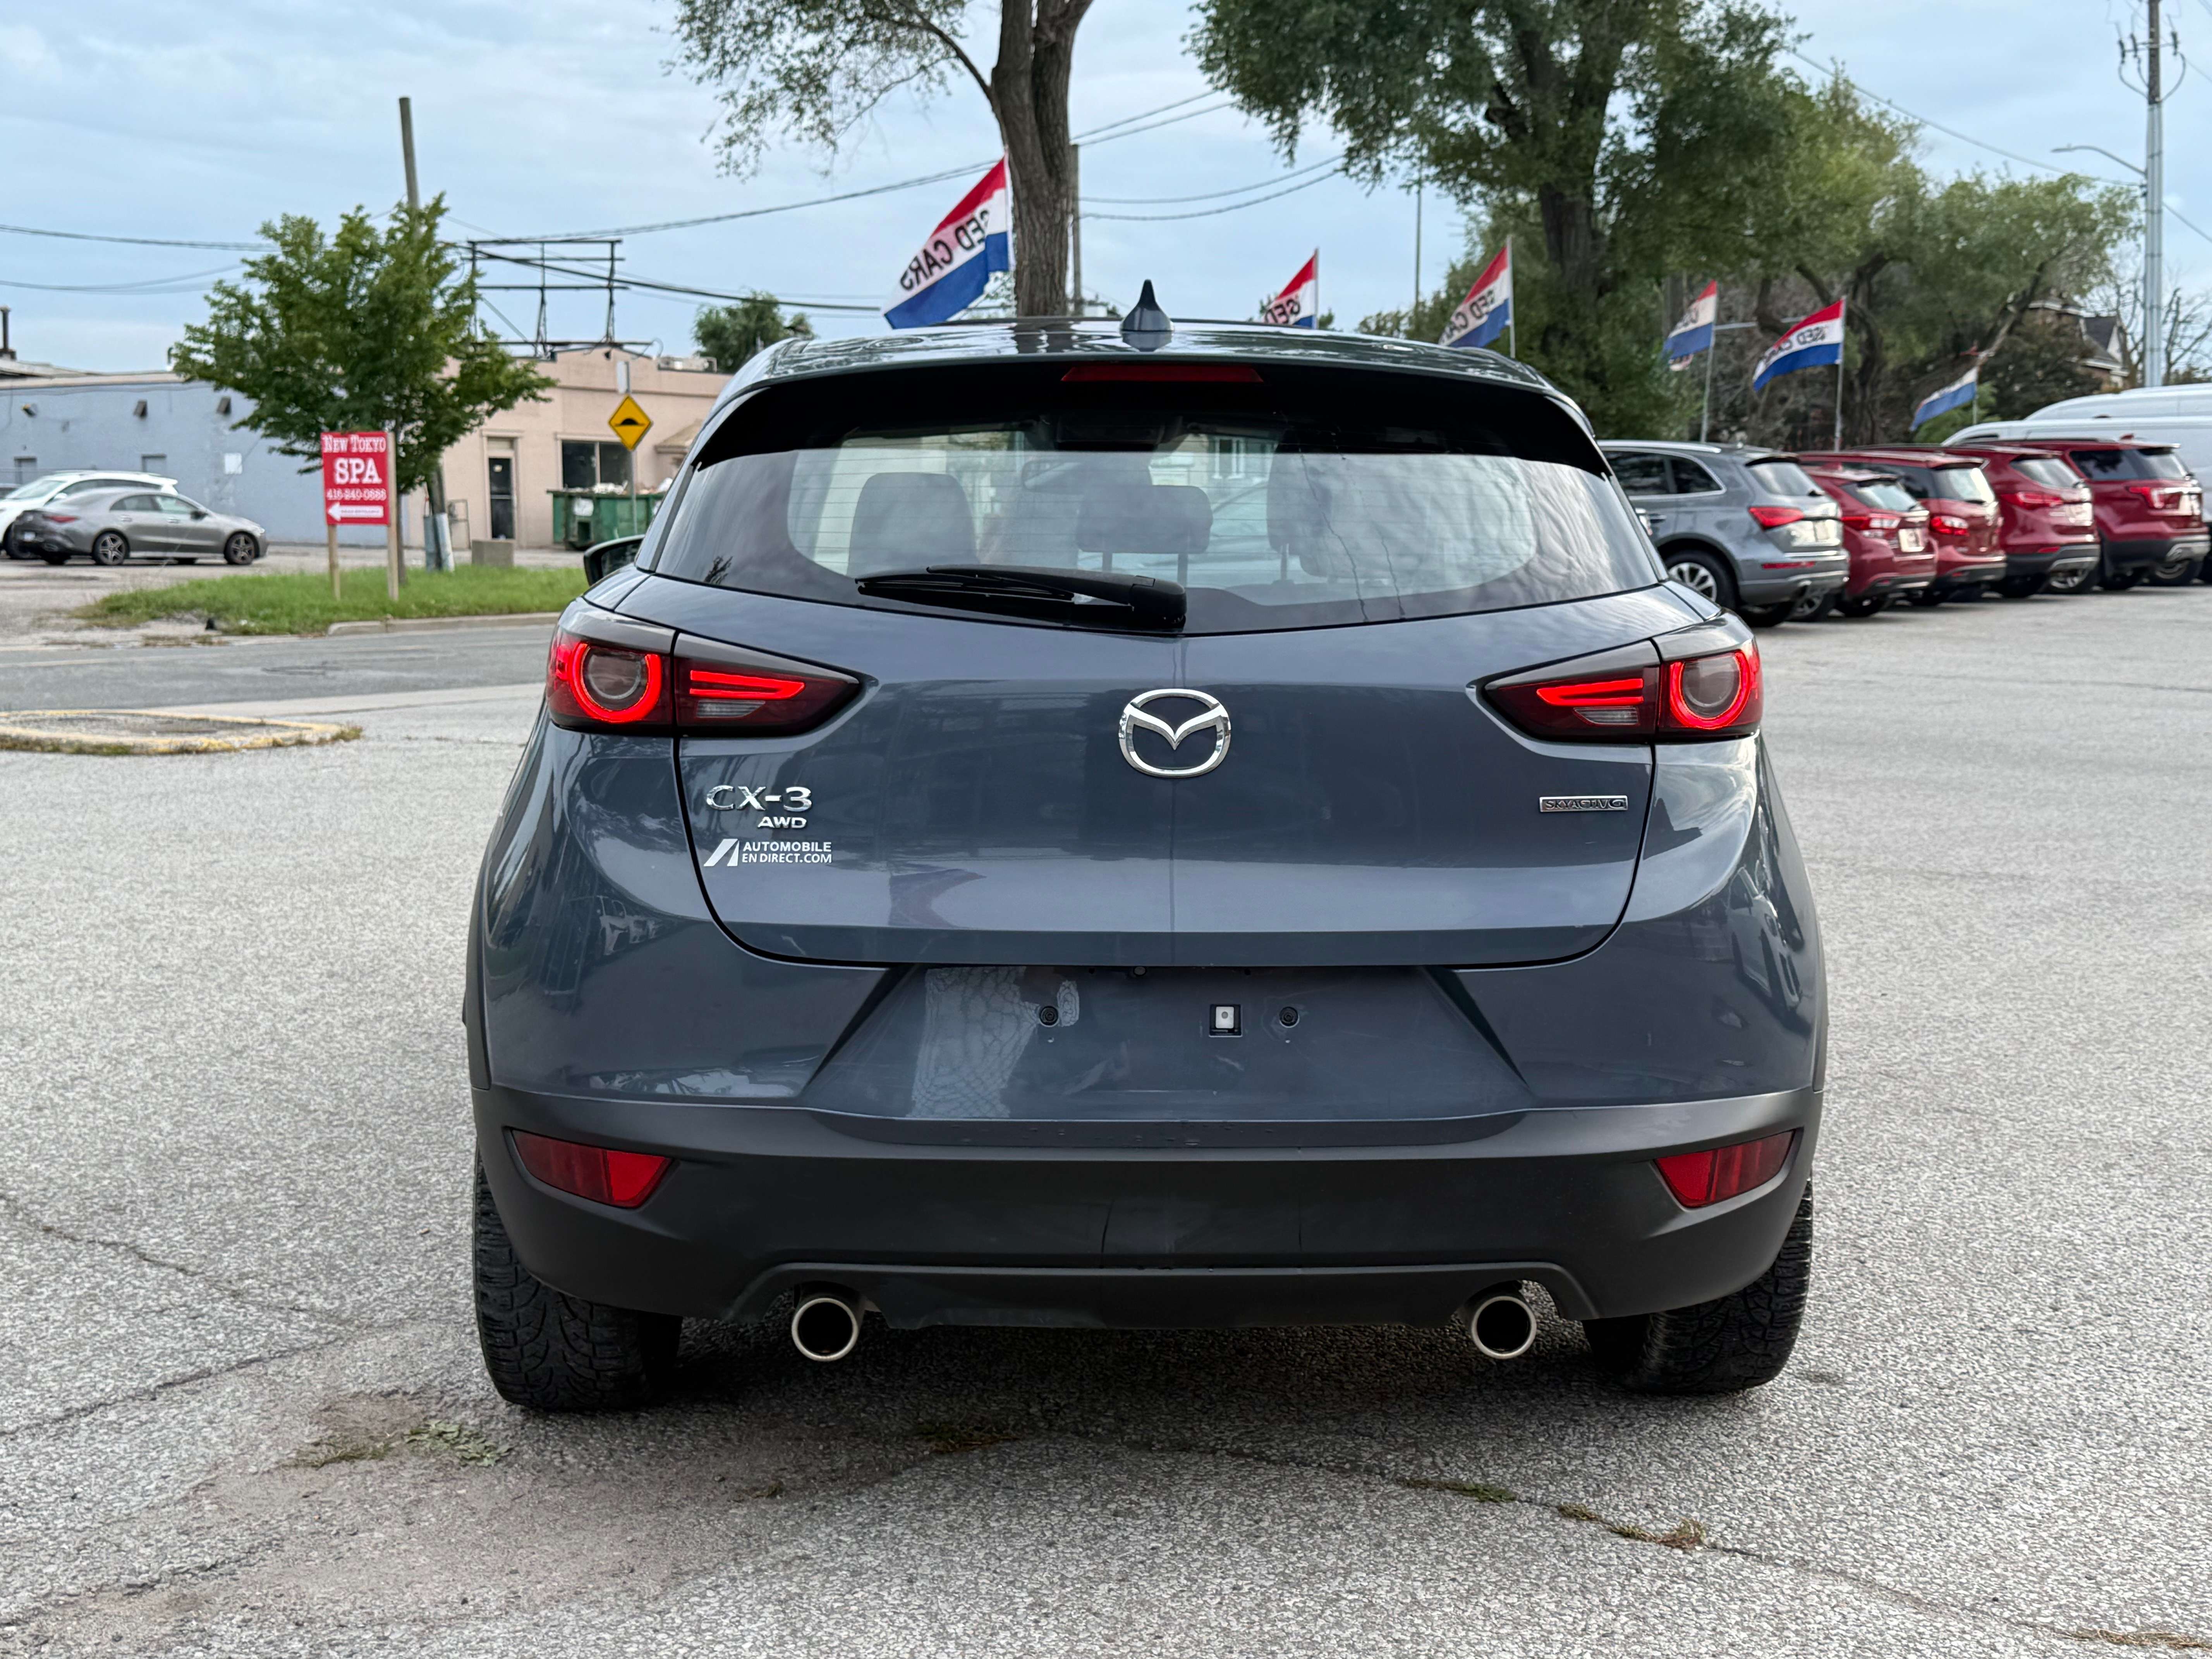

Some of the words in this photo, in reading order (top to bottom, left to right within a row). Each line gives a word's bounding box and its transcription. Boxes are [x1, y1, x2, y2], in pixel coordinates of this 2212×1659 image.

[350, 434, 386, 452] TOKYO
[335, 457, 382, 484] SPA
[706, 785, 812, 812] CX-3
[757, 816, 807, 829] AWD
[743, 842, 832, 852] AUTOMOBILE
[742, 854, 757, 863] EN
[760, 854, 832, 863] DIRECT.COM
